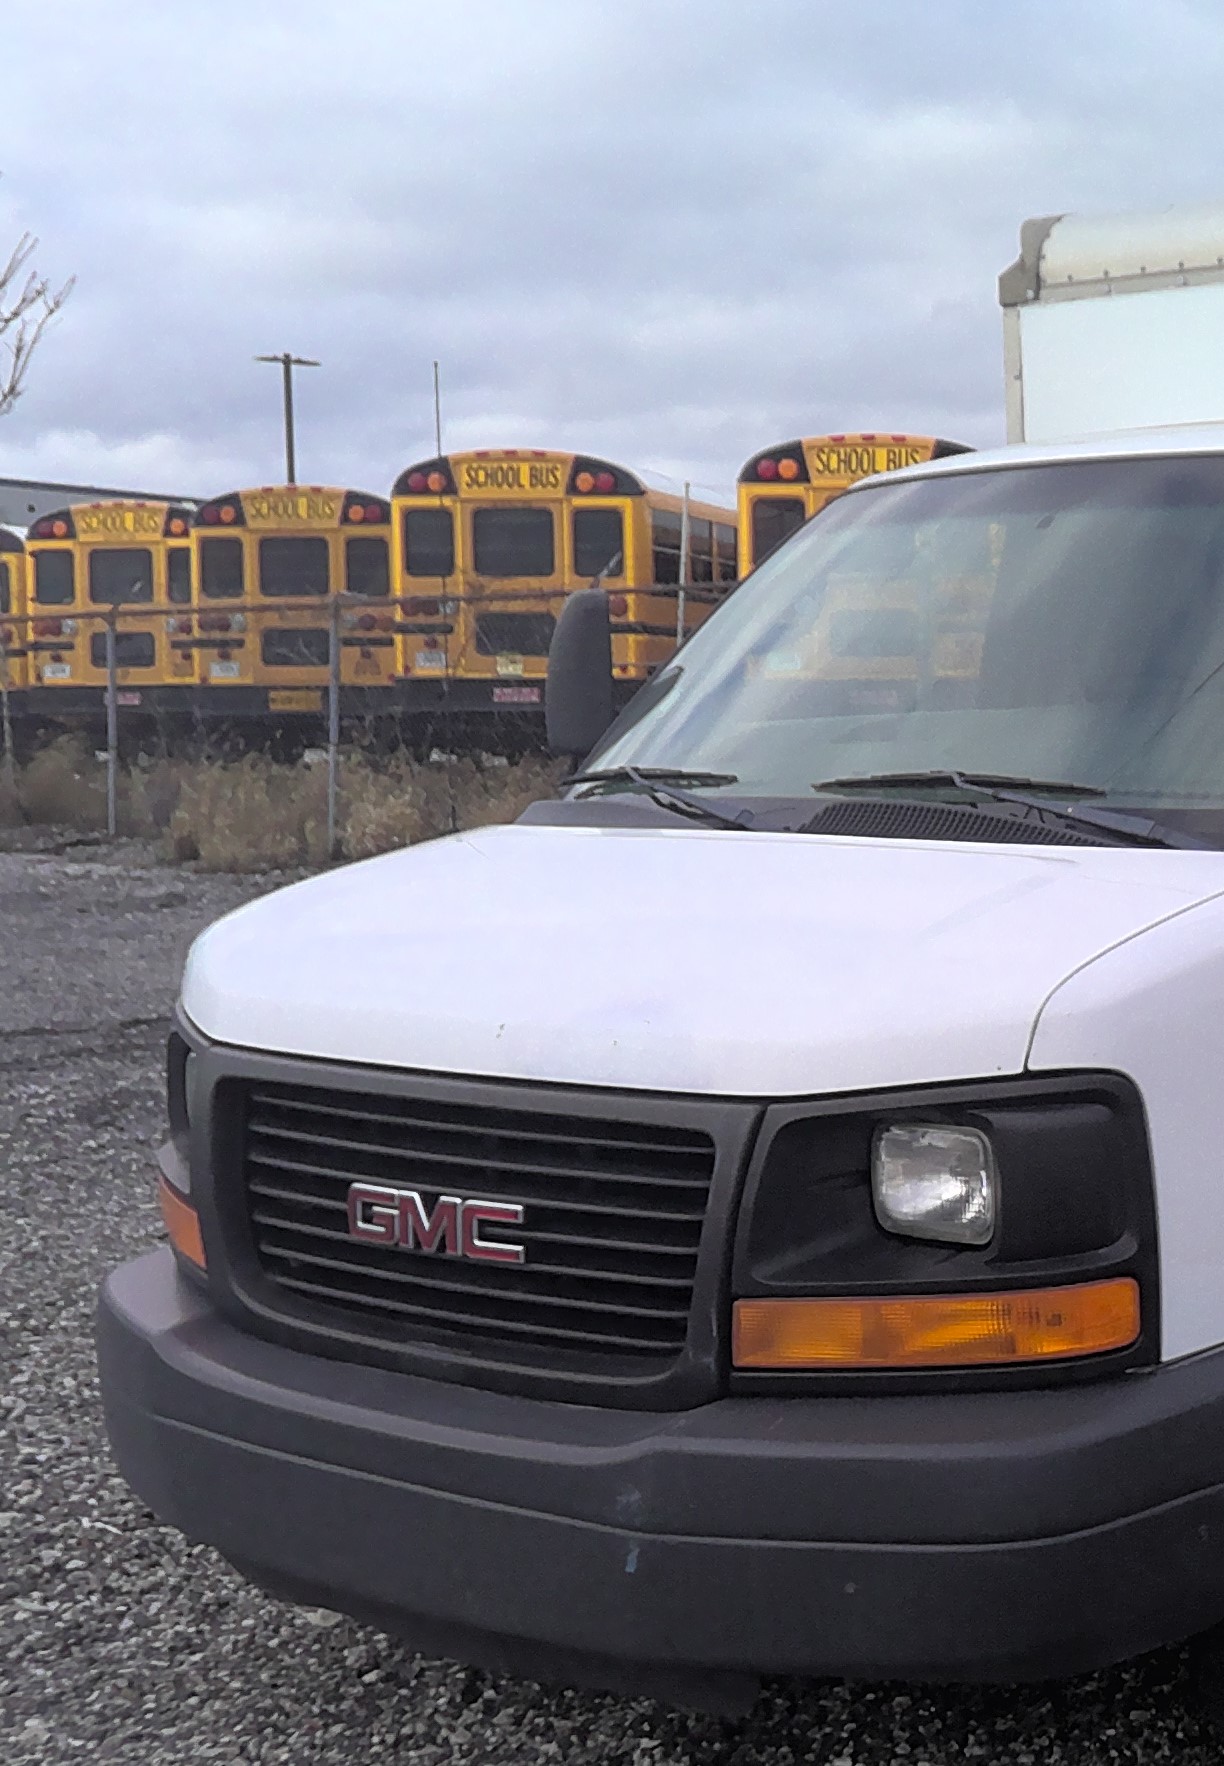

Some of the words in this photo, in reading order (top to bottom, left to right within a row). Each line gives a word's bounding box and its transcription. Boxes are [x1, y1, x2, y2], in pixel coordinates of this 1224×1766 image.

[816, 447, 881, 475] SCHOOL
[886, 447, 920, 471] BUS
[465, 463, 526, 489] SCHOOL
[529, 463, 560, 489] BUS
[251, 495, 304, 519] SCHOOL
[347, 1182, 526, 1264] GMC
